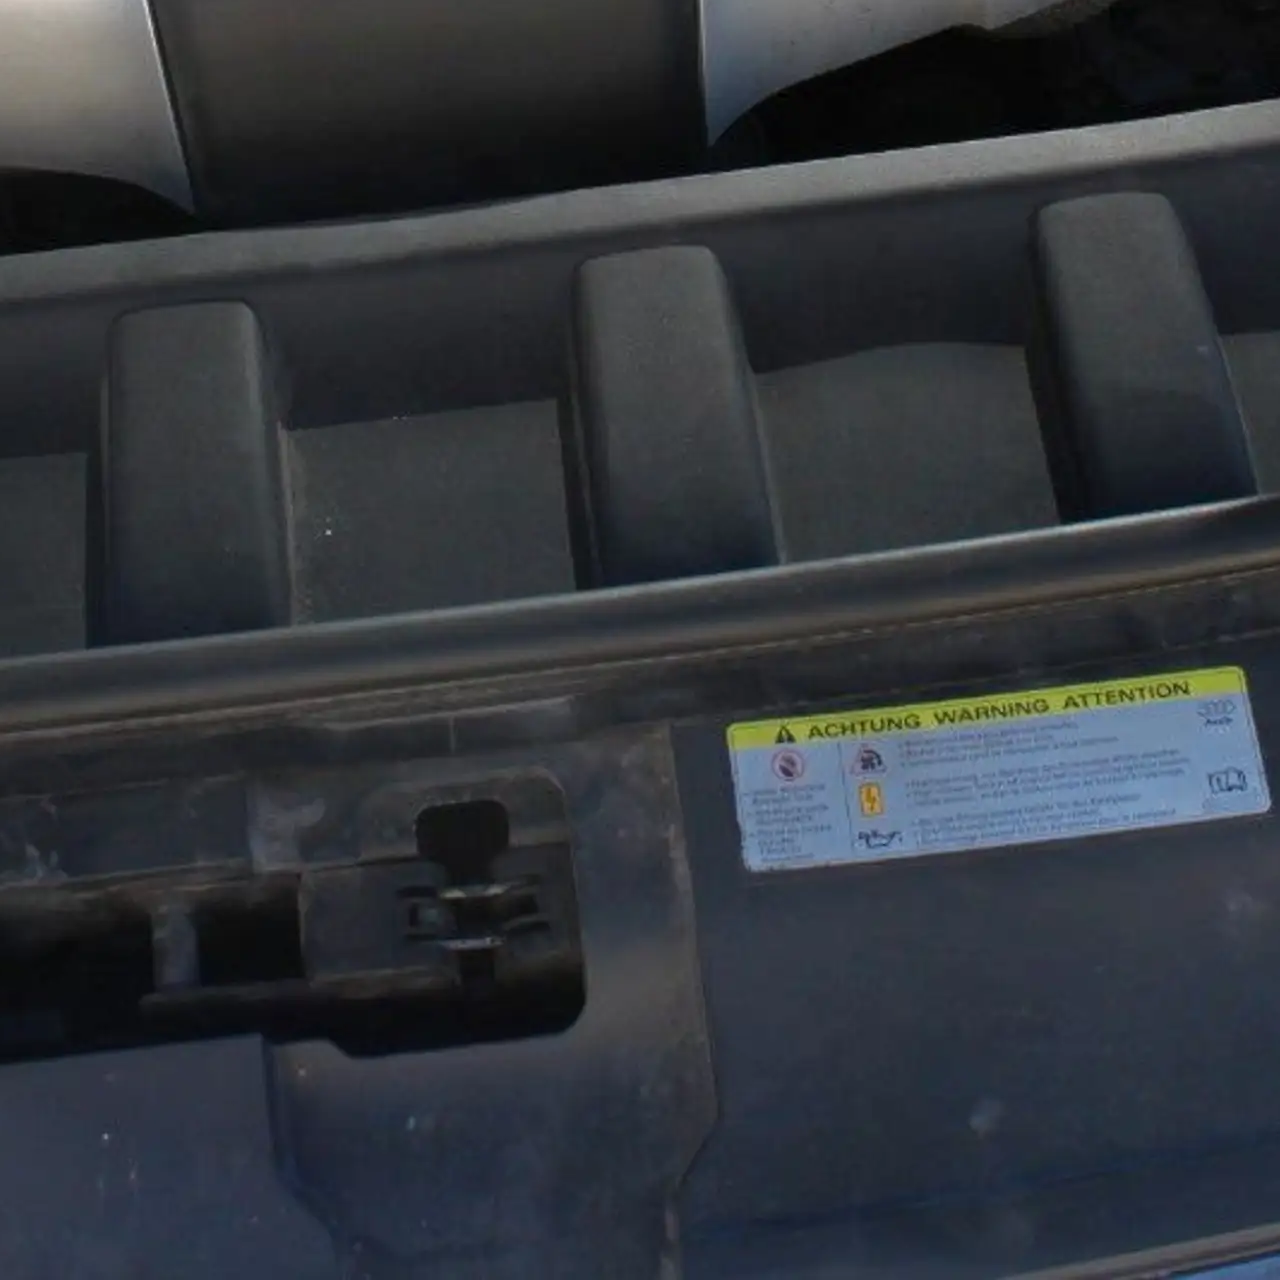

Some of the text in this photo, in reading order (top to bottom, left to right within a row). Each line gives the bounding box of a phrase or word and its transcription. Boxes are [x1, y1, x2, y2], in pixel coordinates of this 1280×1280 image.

[807, 679, 1192, 740] ACHTUNG WARNING ATTENTION
